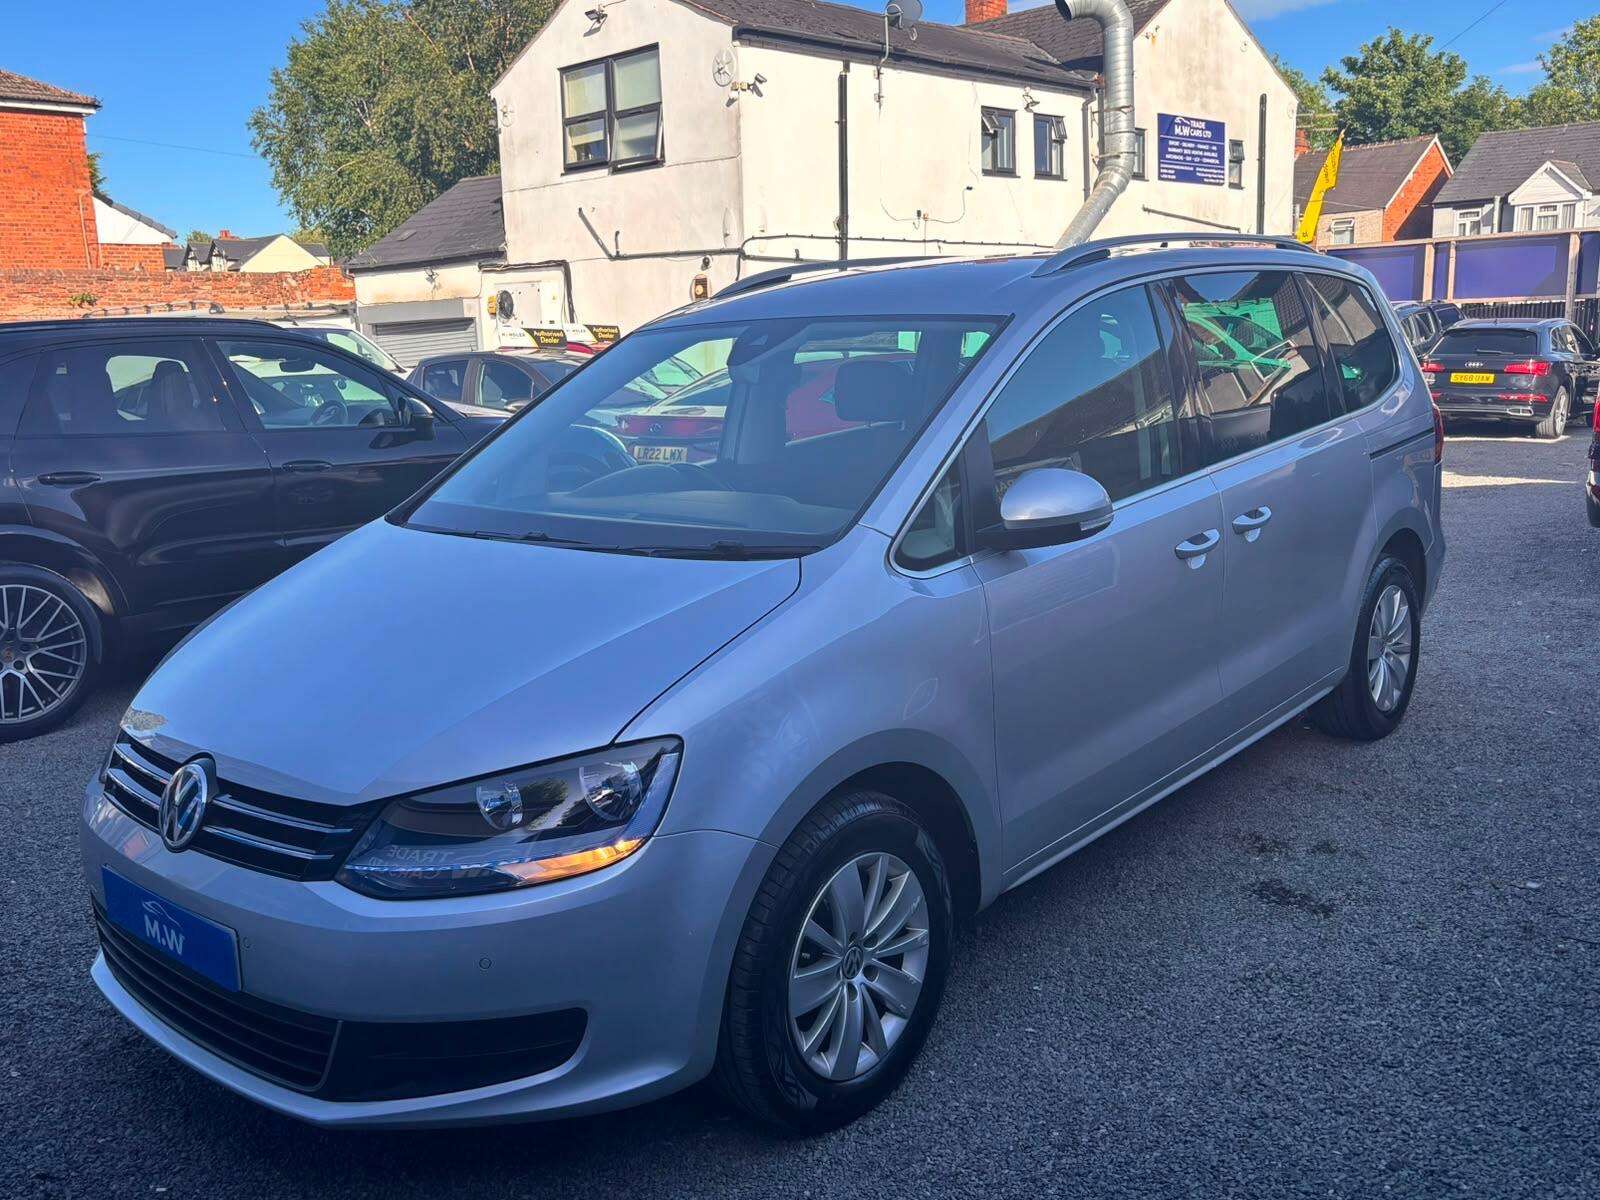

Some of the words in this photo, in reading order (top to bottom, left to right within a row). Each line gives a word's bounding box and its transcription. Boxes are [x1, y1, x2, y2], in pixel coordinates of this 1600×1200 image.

[1190, 120, 1206, 129] TRADE
[1190, 128, 1203, 137] CARS
[1203, 130, 1212, 138] LTD
[540, 336, 560, 344] Dealer
[637, 447, 662, 460] LR22
[663, 447, 684, 462] LMX
[144, 913, 185, 957] M.W
